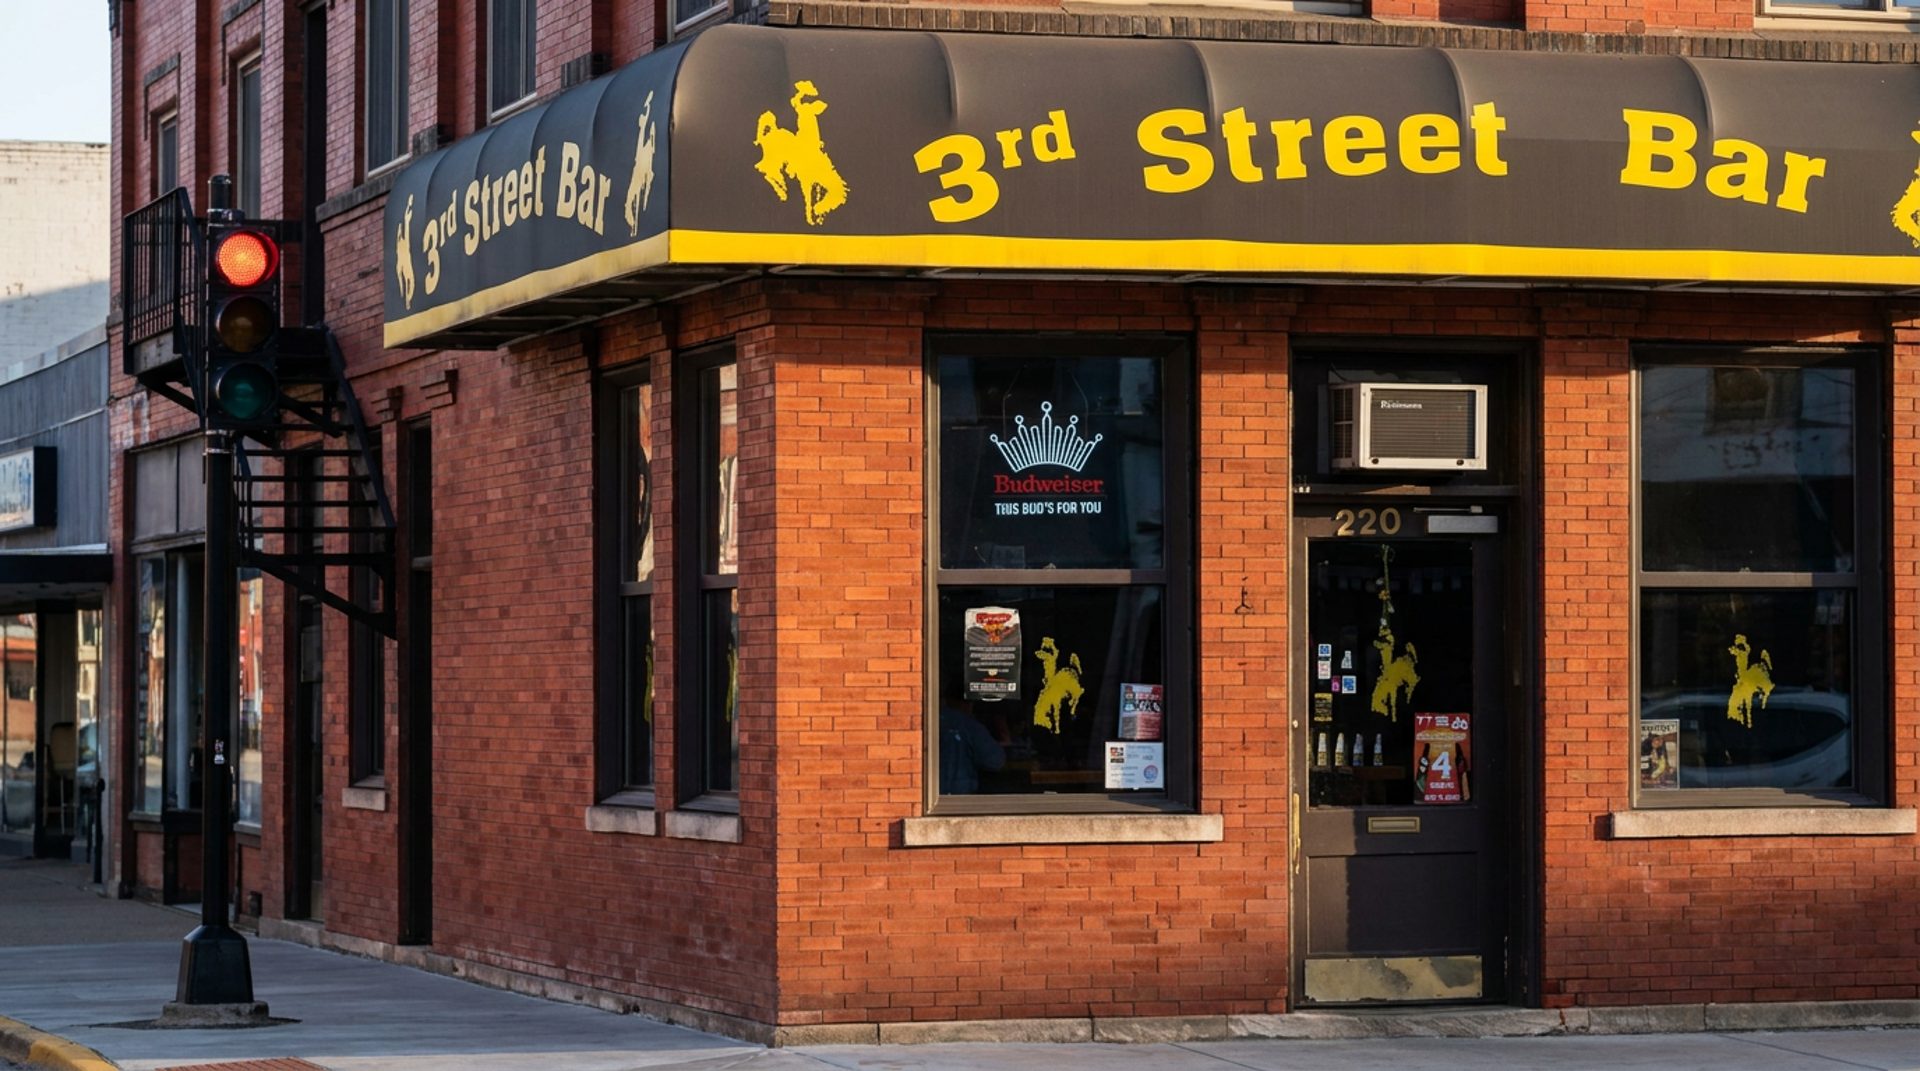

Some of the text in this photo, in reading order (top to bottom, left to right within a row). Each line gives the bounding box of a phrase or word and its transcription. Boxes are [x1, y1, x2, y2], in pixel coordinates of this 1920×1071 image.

[913, 101, 1827, 223] 3rd Street Bar
[423, 141, 611, 295] 3rd Street Bar
[993, 474, 1104, 494] Budweiser
[1022, 502, 1055, 515] BUD'S
[1057, 501, 1078, 514] FOR
[1080, 501, 1102, 514] YOU
[1335, 507, 1401, 537] 220
[1431, 751, 1451, 779] 4
